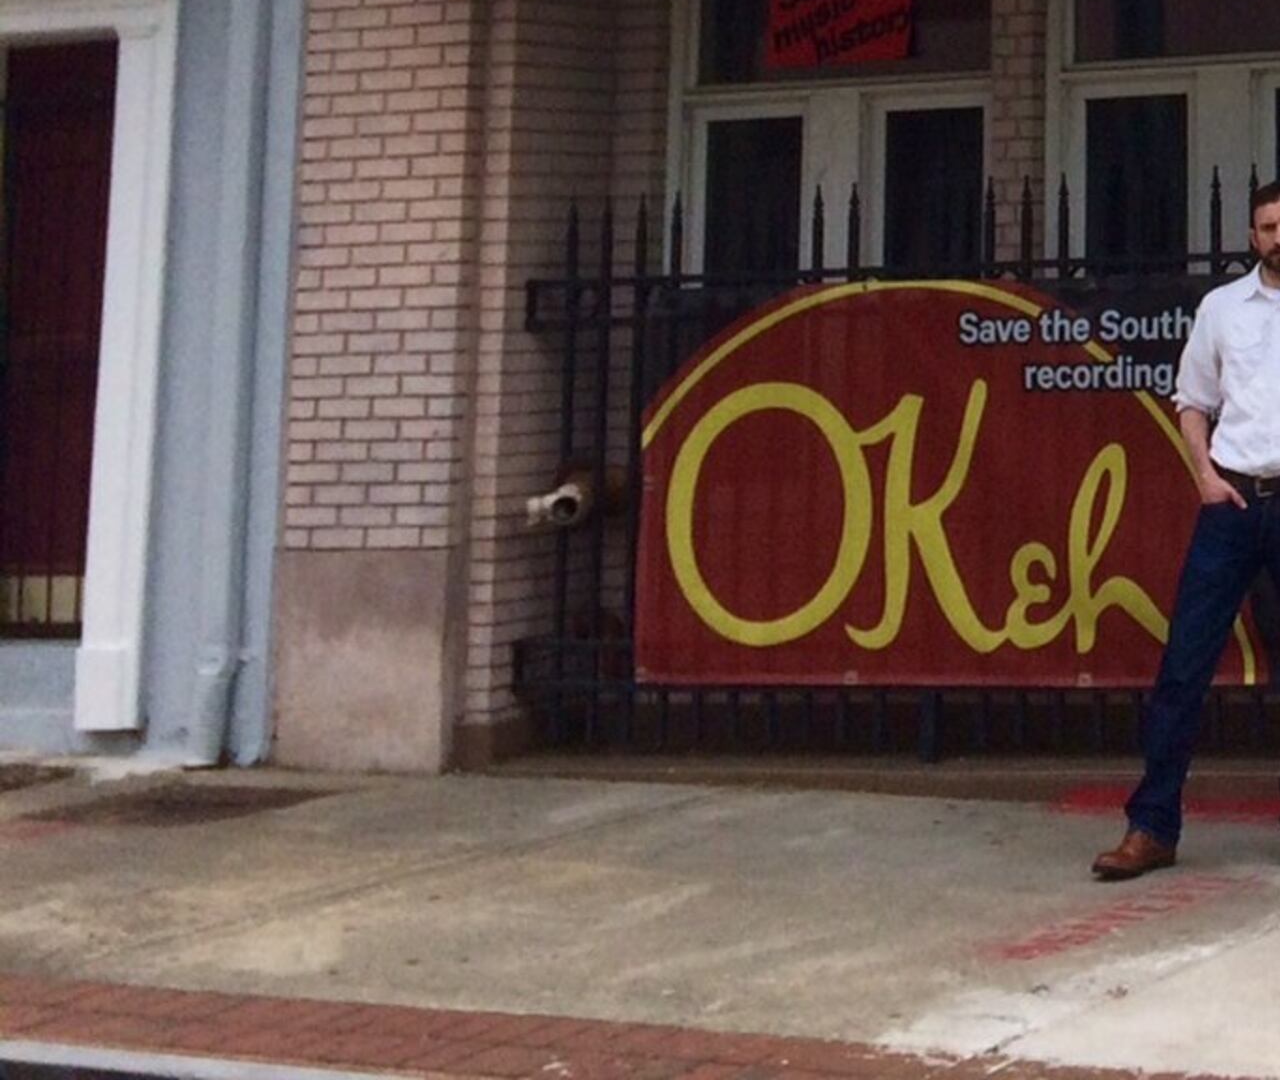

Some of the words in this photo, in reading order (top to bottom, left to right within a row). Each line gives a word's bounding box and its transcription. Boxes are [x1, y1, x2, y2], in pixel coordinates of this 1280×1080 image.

[959, 312, 1031, 343] Save
[1040, 309, 1090, 342] the
[1024, 355, 1173, 396] recording
